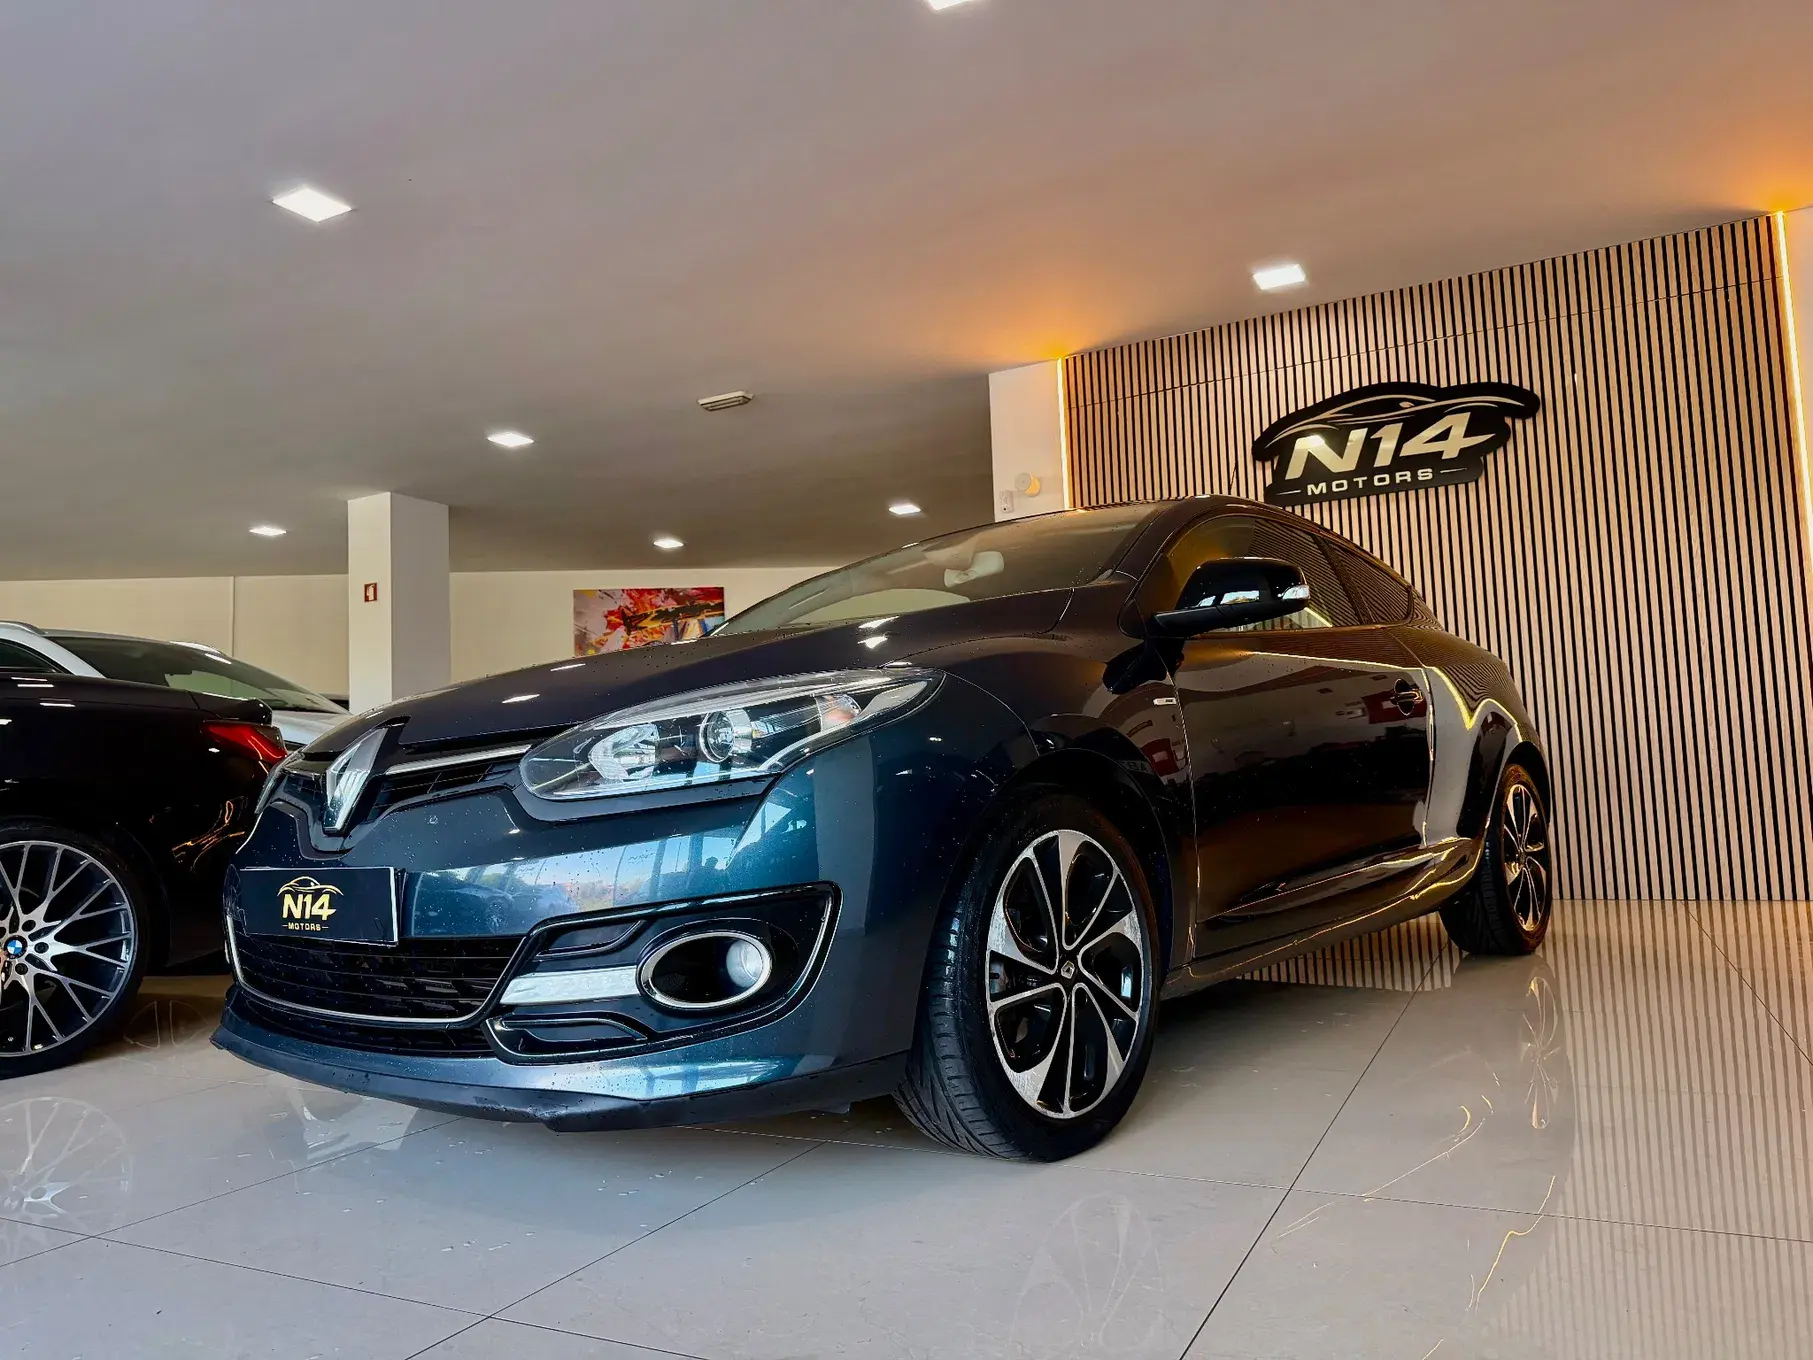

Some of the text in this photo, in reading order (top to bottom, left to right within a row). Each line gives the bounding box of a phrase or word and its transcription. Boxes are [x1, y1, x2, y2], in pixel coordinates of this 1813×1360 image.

[1284, 411, 1496, 481] N14
[1306, 467, 1434, 496] MOTORS
[282, 893, 337, 921] N14
[287, 922, 321, 931] MOTORS
